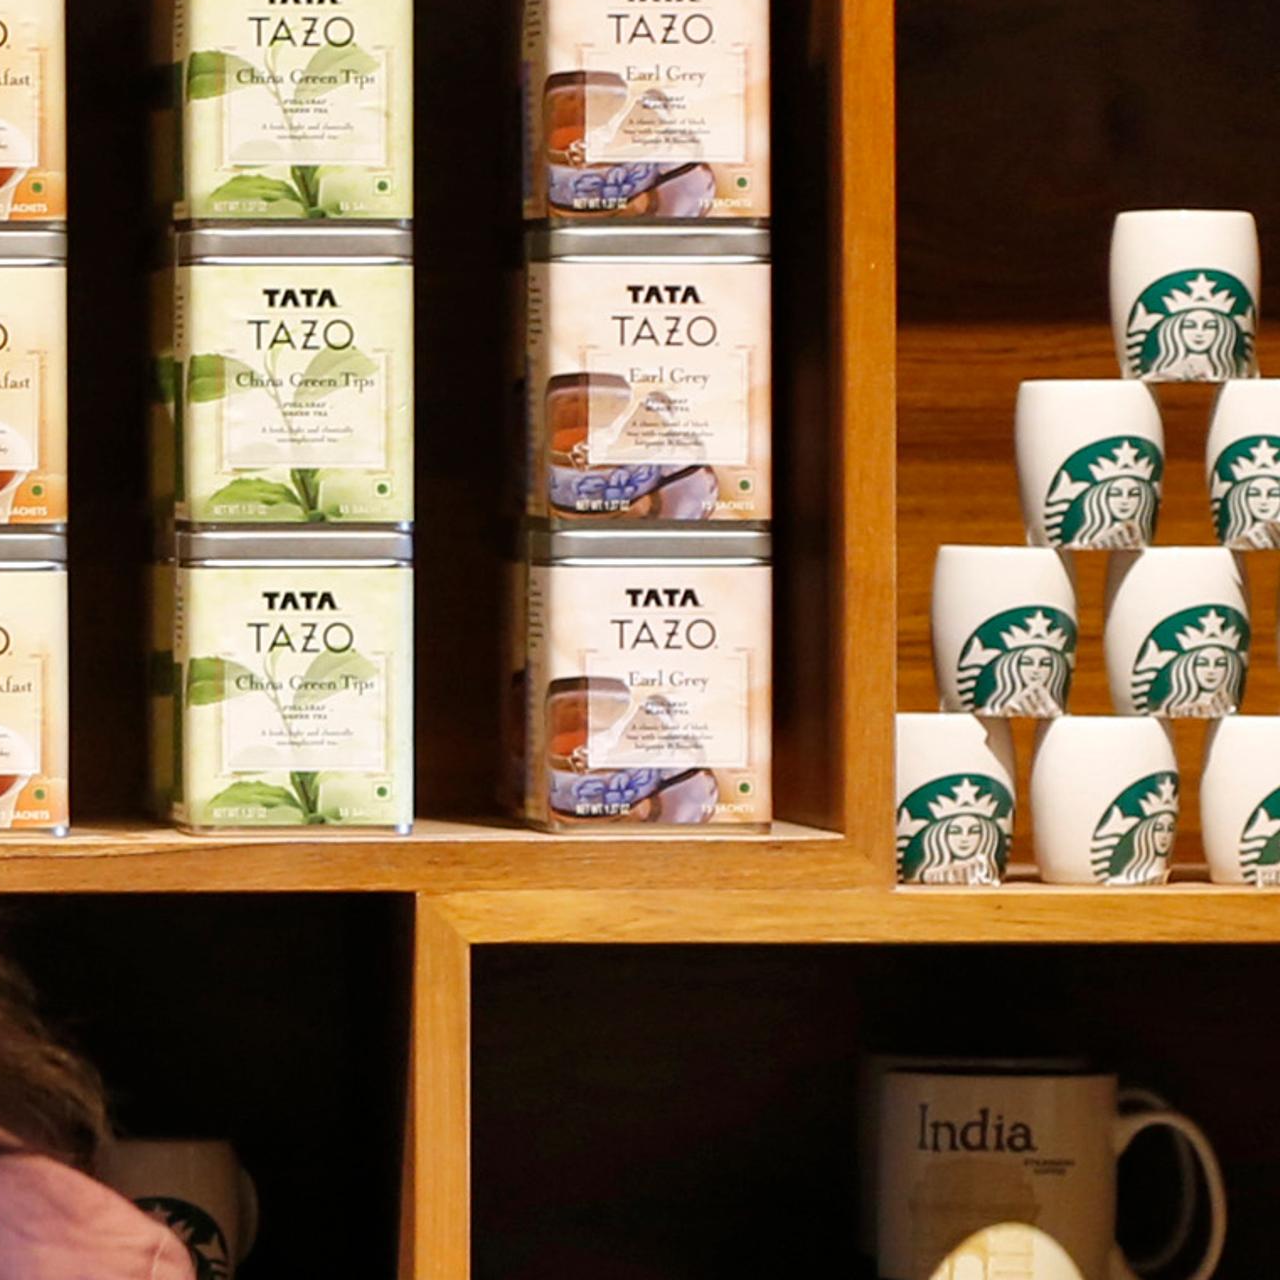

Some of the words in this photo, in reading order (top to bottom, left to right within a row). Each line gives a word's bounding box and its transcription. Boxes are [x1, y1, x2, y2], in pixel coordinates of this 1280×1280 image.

[248, 16, 355, 47] TAZO
[607, 13, 714, 44] TAZO
[236, 68, 284, 85] China
[290, 69, 338, 85] Green
[342, 68, 375, 90] Tips
[625, 64, 660, 82] Earl
[666, 66, 707, 87] Grey
[263, 289, 338, 307] TATA
[627, 285, 701, 303] TATA
[248, 320, 354, 350] TAZO
[611, 316, 718, 346] TAZO
[235, 371, 284, 388] China
[289, 372, 337, 388] Green
[342, 371, 375, 393] Tips
[629, 366, 664, 384] Earl
[669, 368, 710, 389] Grey
[262, 591, 338, 610] TATA
[625, 588, 700, 607] TATA
[247, 622, 354, 653] TAZO
[610, 618, 717, 649] TAZO
[235, 673, 283, 691] China
[289, 674, 337, 690] Green
[341, 674, 374, 695] Tips
[628, 670, 663, 687] Earl
[668, 671, 709, 692] Grey
[917, 1103, 1038, 1152] India
